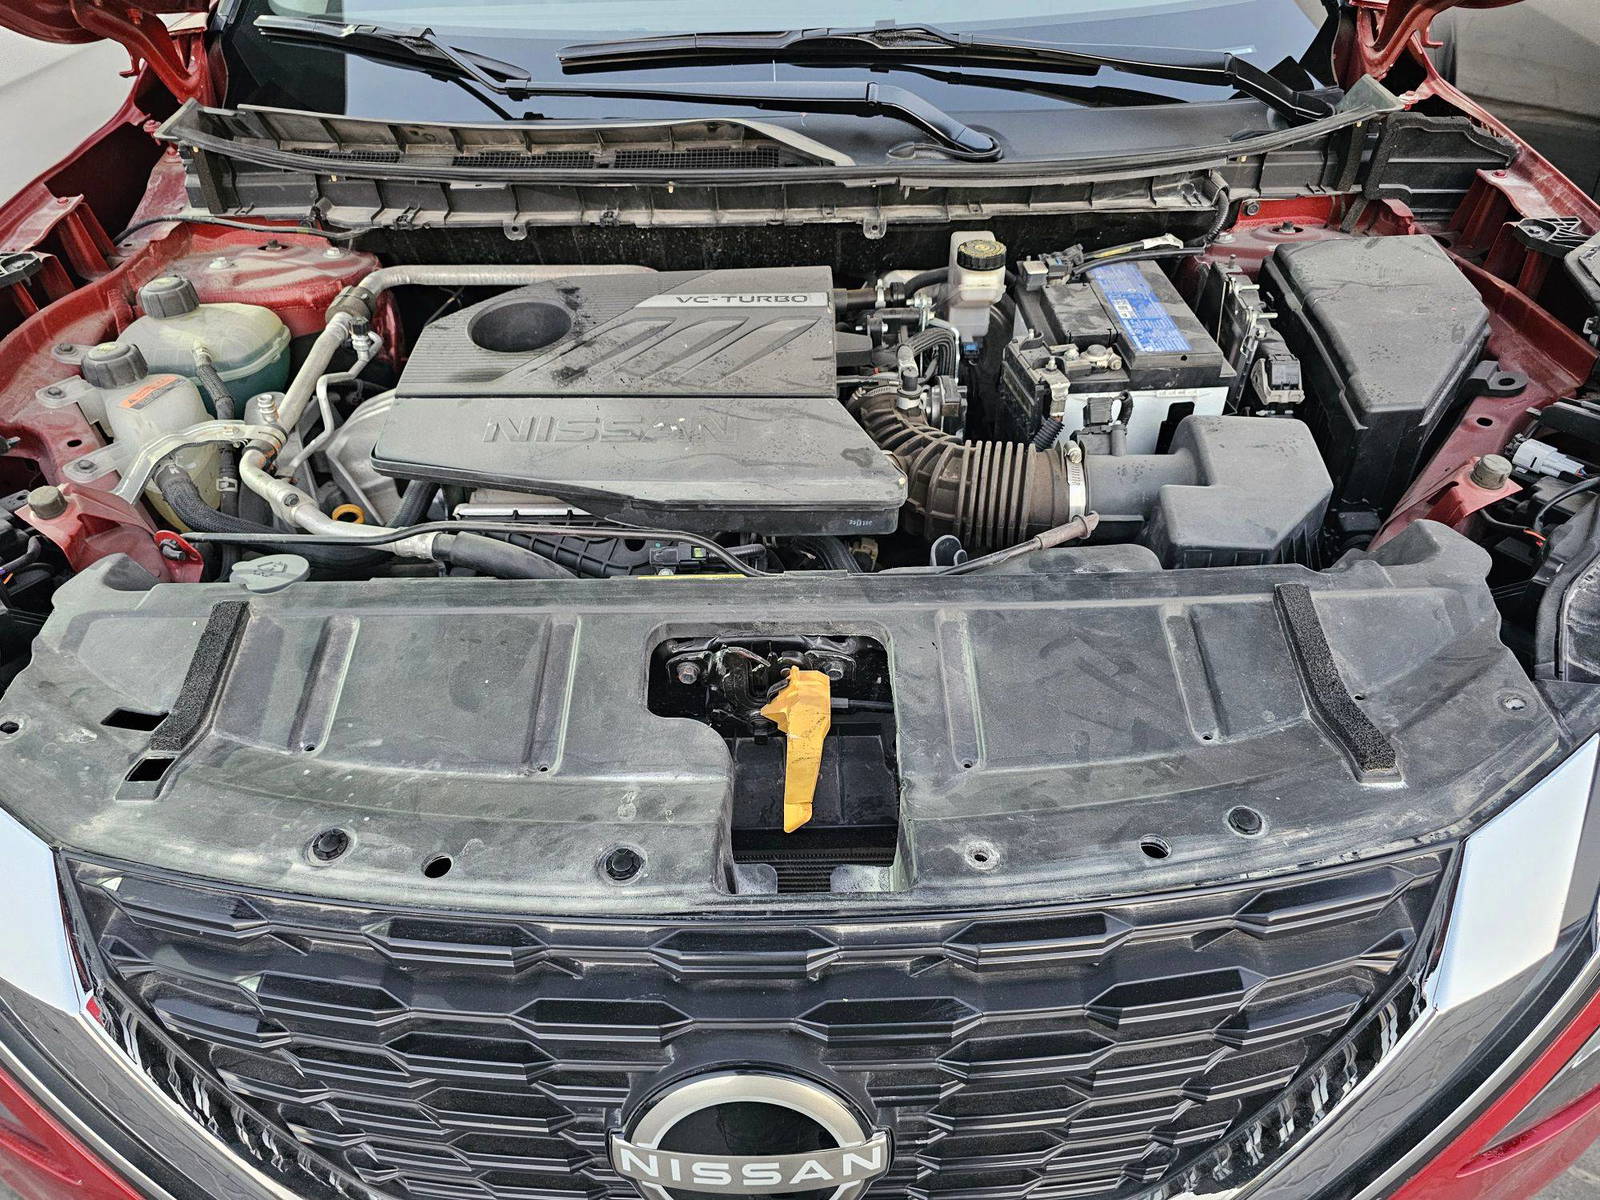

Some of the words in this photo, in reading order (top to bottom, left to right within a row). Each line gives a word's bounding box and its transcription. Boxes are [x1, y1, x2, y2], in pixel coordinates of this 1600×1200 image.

[676, 294, 808, 304] VC-TURBO
[482, 414, 740, 444] NISSAN
[620, 1146, 882, 1186] NISSAN
